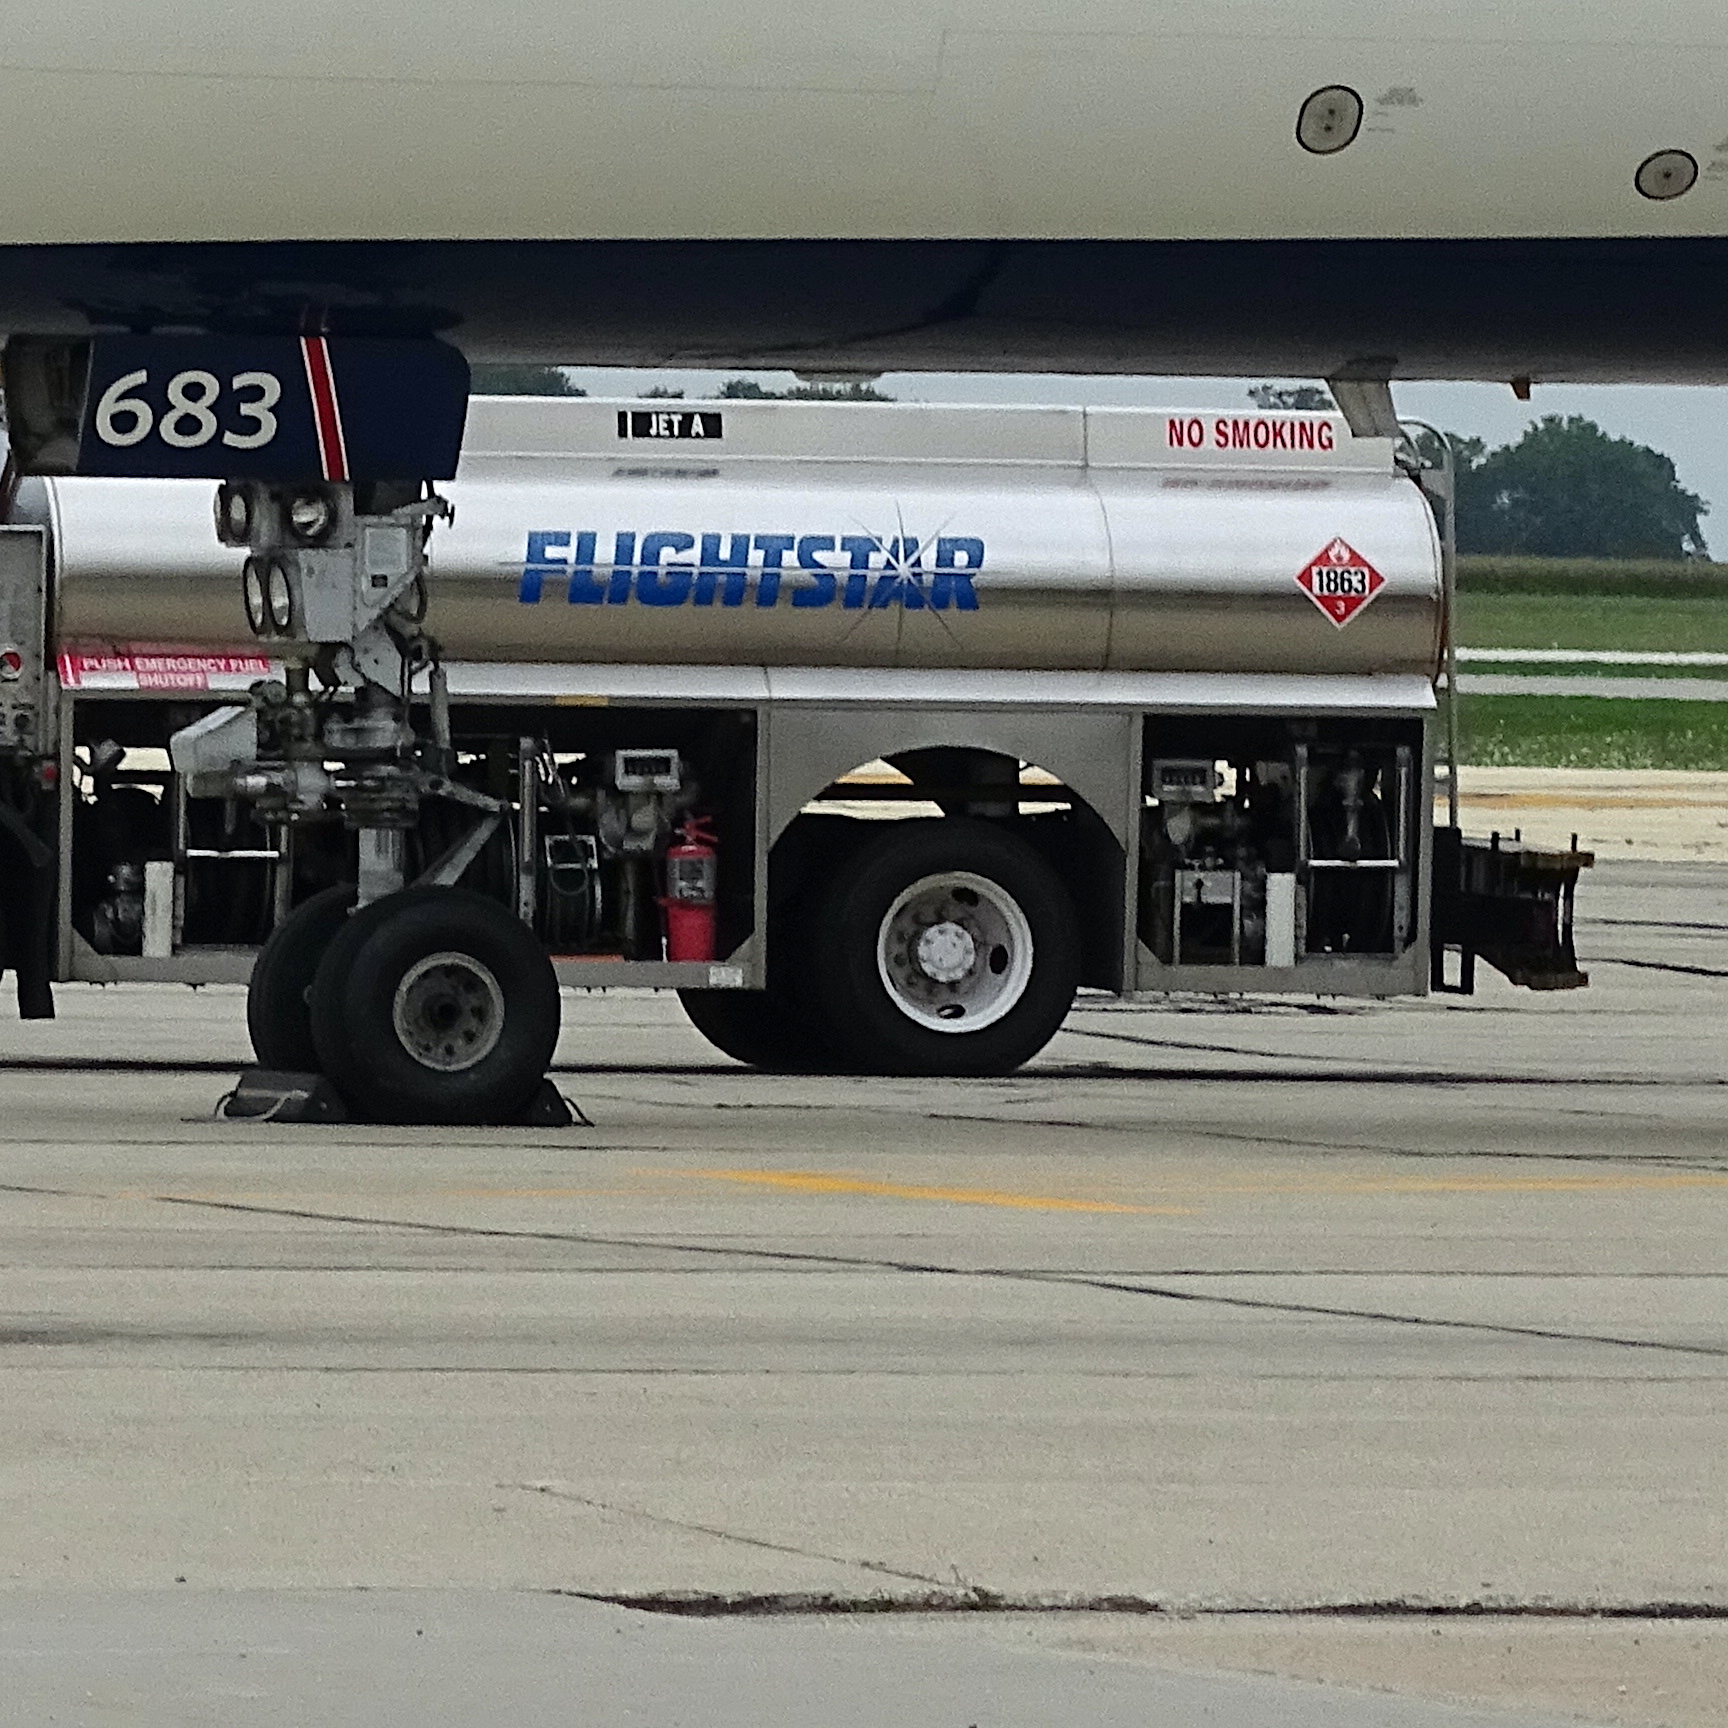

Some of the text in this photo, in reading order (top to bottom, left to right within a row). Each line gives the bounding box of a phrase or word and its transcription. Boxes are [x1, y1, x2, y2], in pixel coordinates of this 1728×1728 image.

[96, 369, 281, 449] 683
[650, 413, 705, 437] JET A
[1169, 418, 1333, 450] NO SMOKING
[519, 531, 985, 610] FLIGHTSTAR
[1316, 568, 1366, 594] 1863
[1335, 600, 1346, 615] 3
[83, 656, 269, 673] PUSH EMERGENCY FUEL
[138, 673, 205, 688] SHUTOFF
